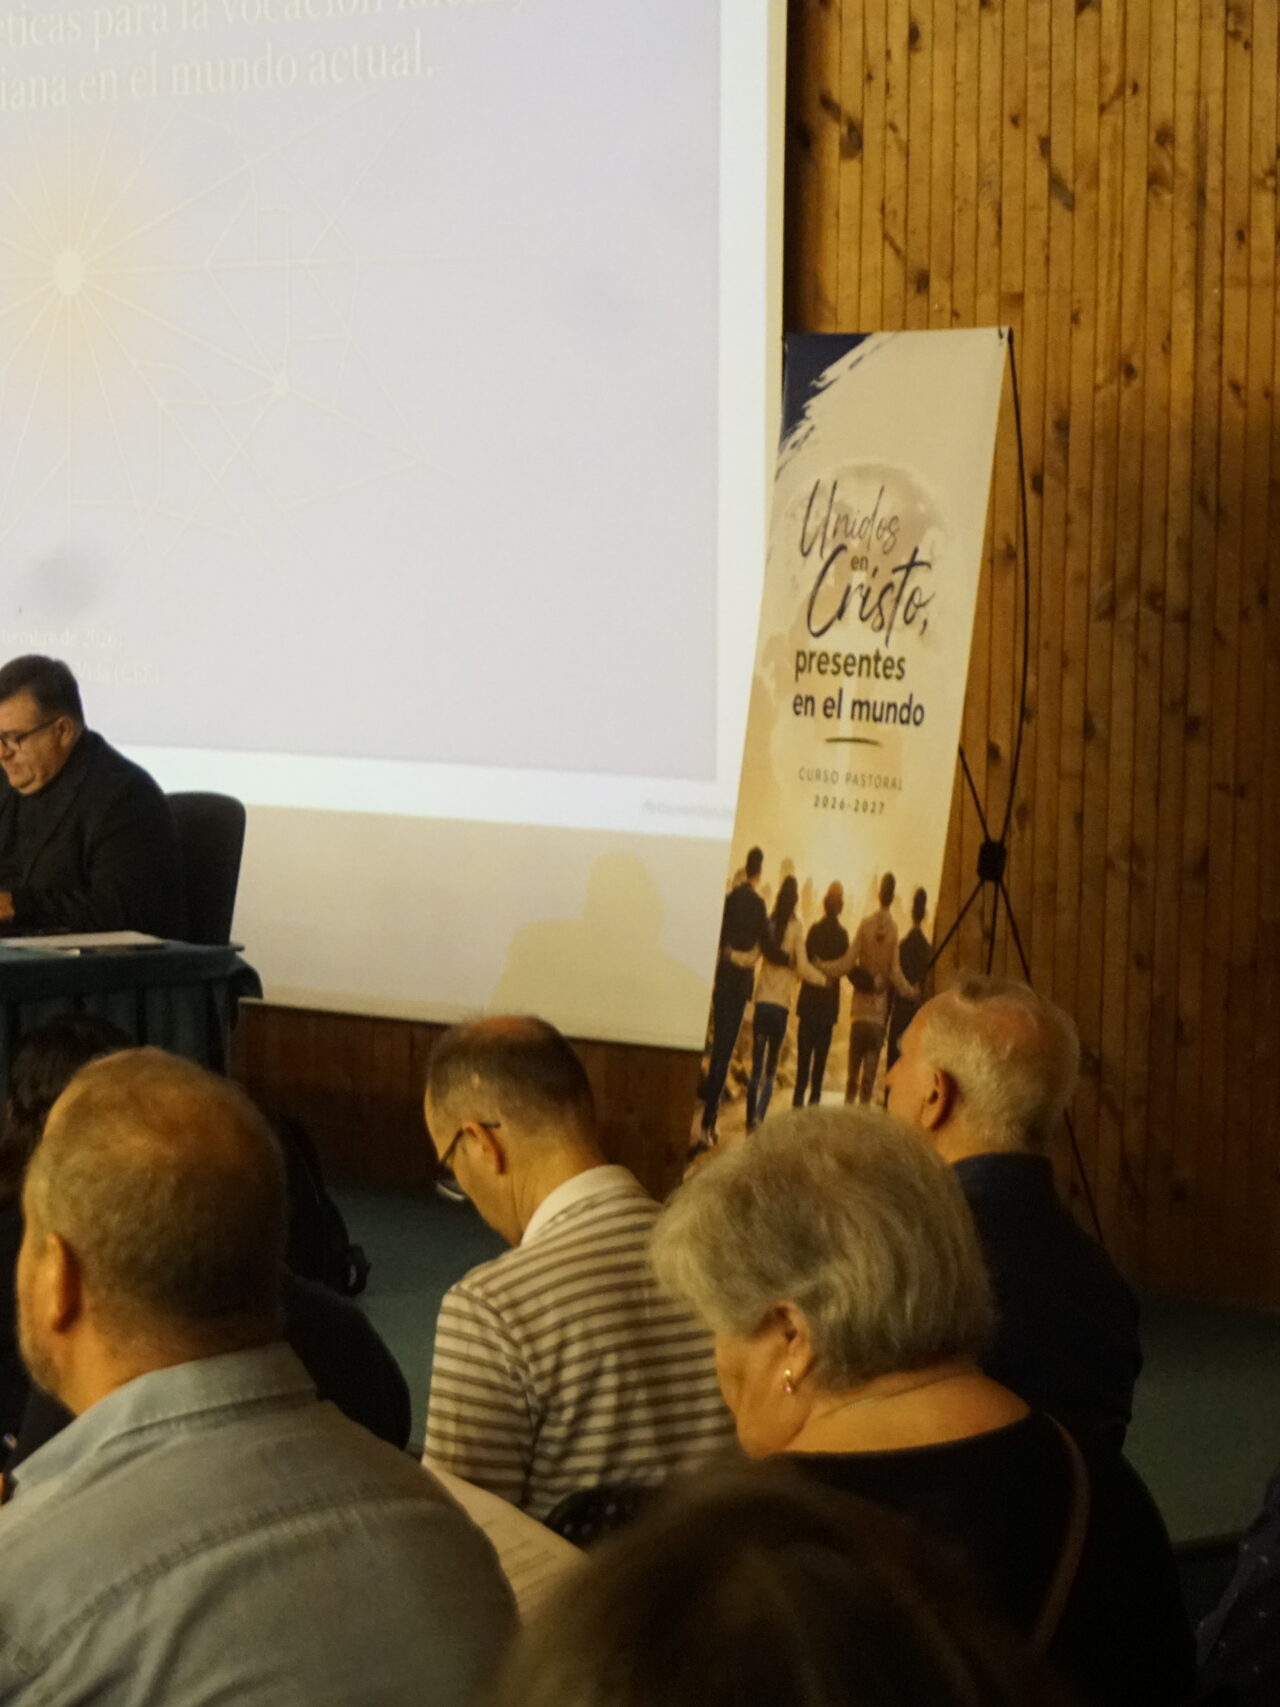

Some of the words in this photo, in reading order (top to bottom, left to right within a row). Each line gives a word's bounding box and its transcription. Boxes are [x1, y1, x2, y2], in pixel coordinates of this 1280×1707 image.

[93, 1, 170, 53] para
[79, 67, 119, 103] en
[129, 49, 158, 101] el
[170, 39, 297, 97] mundo
[308, 27, 434, 86] actual.
[799, 478, 901, 561] Unidos
[850, 554, 869, 573] en
[794, 648, 906, 683] presentes
[792, 691, 815, 718] en
[822, 688, 843, 720] el
[850, 692, 925, 727] mundo
[798, 765, 839, 785] CURSO
[845, 771, 904, 792] PASTORAL
